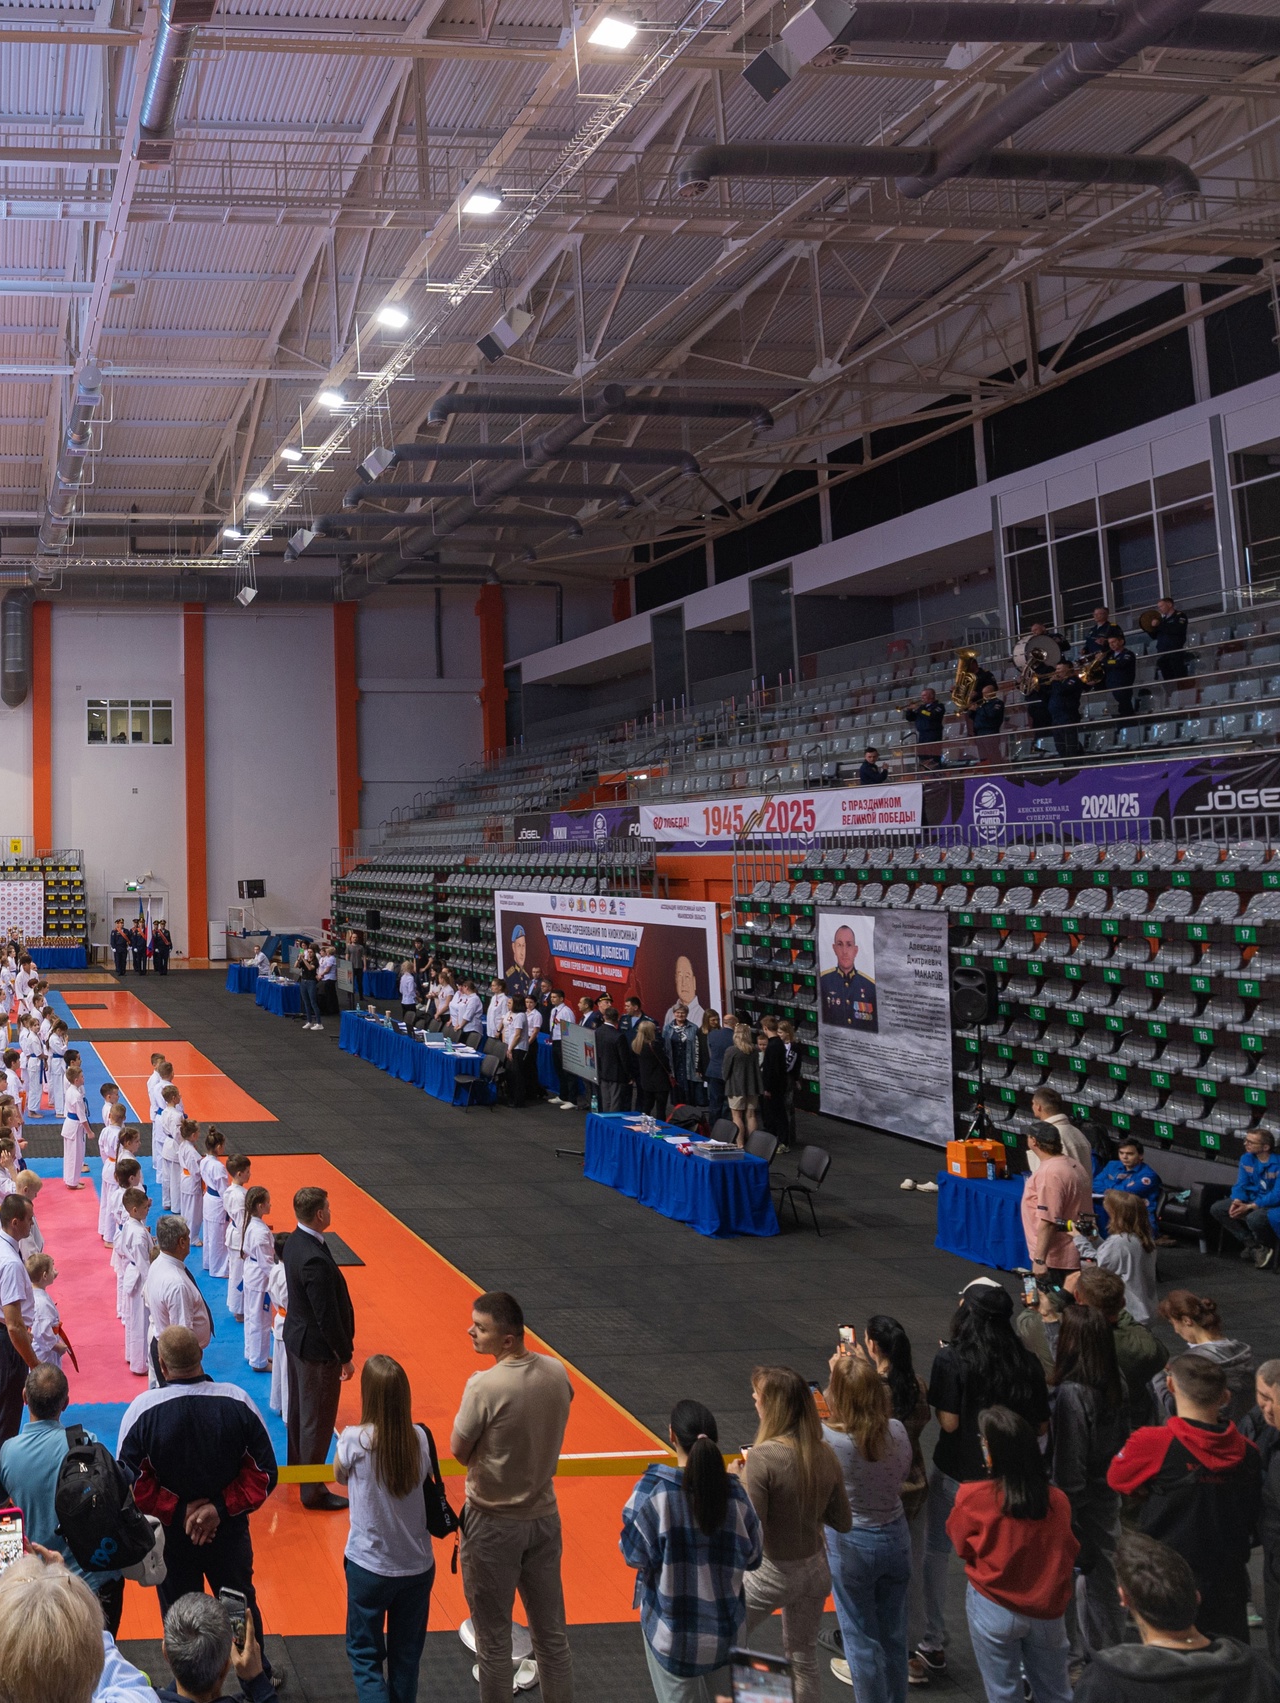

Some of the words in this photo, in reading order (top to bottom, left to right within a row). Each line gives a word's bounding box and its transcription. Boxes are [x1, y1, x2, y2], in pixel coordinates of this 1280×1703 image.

[841, 800, 847, 811] С
[849, 797, 902, 812] ПРАЗДНИКОМ
[1045, 805, 1070, 813] КОМАНД
[1081, 793, 1139, 819] 2024/25
[663, 816, 690, 829] ПОБЕДА!
[702, 804, 744, 836] 1945
[765, 799, 817, 833] 2025
[841, 812, 877, 826] ВЕЛИКОЙ
[878, 811, 916, 825] ПОБЕДЫ!
[1026, 813, 1061, 821] СУПЕРЛИГИ
[517, 828, 541, 840] JÖGEL
[1027, 872, 1035, 881] 10
[1097, 873, 1105, 883] 12
[1136, 873, 1145, 883] 13
[1176, 874, 1186, 884] 14
[1221, 874, 1230, 884] 15
[1268, 875, 1278, 885] 16
[963, 915, 970, 924] 10
[1029, 918, 1038, 928] 12
[1066, 920, 1075, 930] 13
[545, 922, 572, 935] РЕГИОНАЛЬНЫЕ
[572, 924, 600, 937] СОРЕВНОВАНИЯ
[601, 927, 607, 938] ПО
[608, 928, 638, 942] КИОКУСИНКАЙ
[1105, 922, 1114, 932] 14
[1148, 924, 1157, 935] 15
[1192, 927, 1203, 937] 16
[1241, 929, 1250, 940] 17
[552, 939, 568, 952] КУБОК
[568, 941, 595, 956] МУЖЕСТВА
[595, 944, 601, 956] И
[601, 945, 630, 961] ДОБЛЕСТИ
[908, 941, 942, 954] Александр
[907, 954, 942, 967] Дмитриевич
[1031, 964, 1040, 973] 12
[1069, 967, 1077, 977] 13
[914, 969, 943, 981] МАКАРОВ
[1107, 971, 1117, 980] 14
[1150, 974, 1159, 985] 15
[1195, 978, 1205, 989] 16
[1244, 983, 1254, 993] 17
[1071, 1013, 1080, 1023] 13
[1110, 1018, 1119, 1028] 14
[1152, 1024, 1162, 1034] 15
[1198, 1030, 1208, 1041] 16
[969, 1041, 976, 1050] 10
[1247, 1037, 1256, 1048] 17
[1036, 1053, 1045, 1063] 12
[1073, 1059, 1082, 1070] 13
[1113, 1067, 1122, 1076] 14
[1156, 1074, 1165, 1085] 15
[1201, 1082, 1212, 1093] 16
[1250, 1091, 1259, 1102] 17
[1117, 1115, 1125, 1126] 14
[1159, 1125, 1169, 1136] 15
[1205, 1135, 1215, 1146] 16
